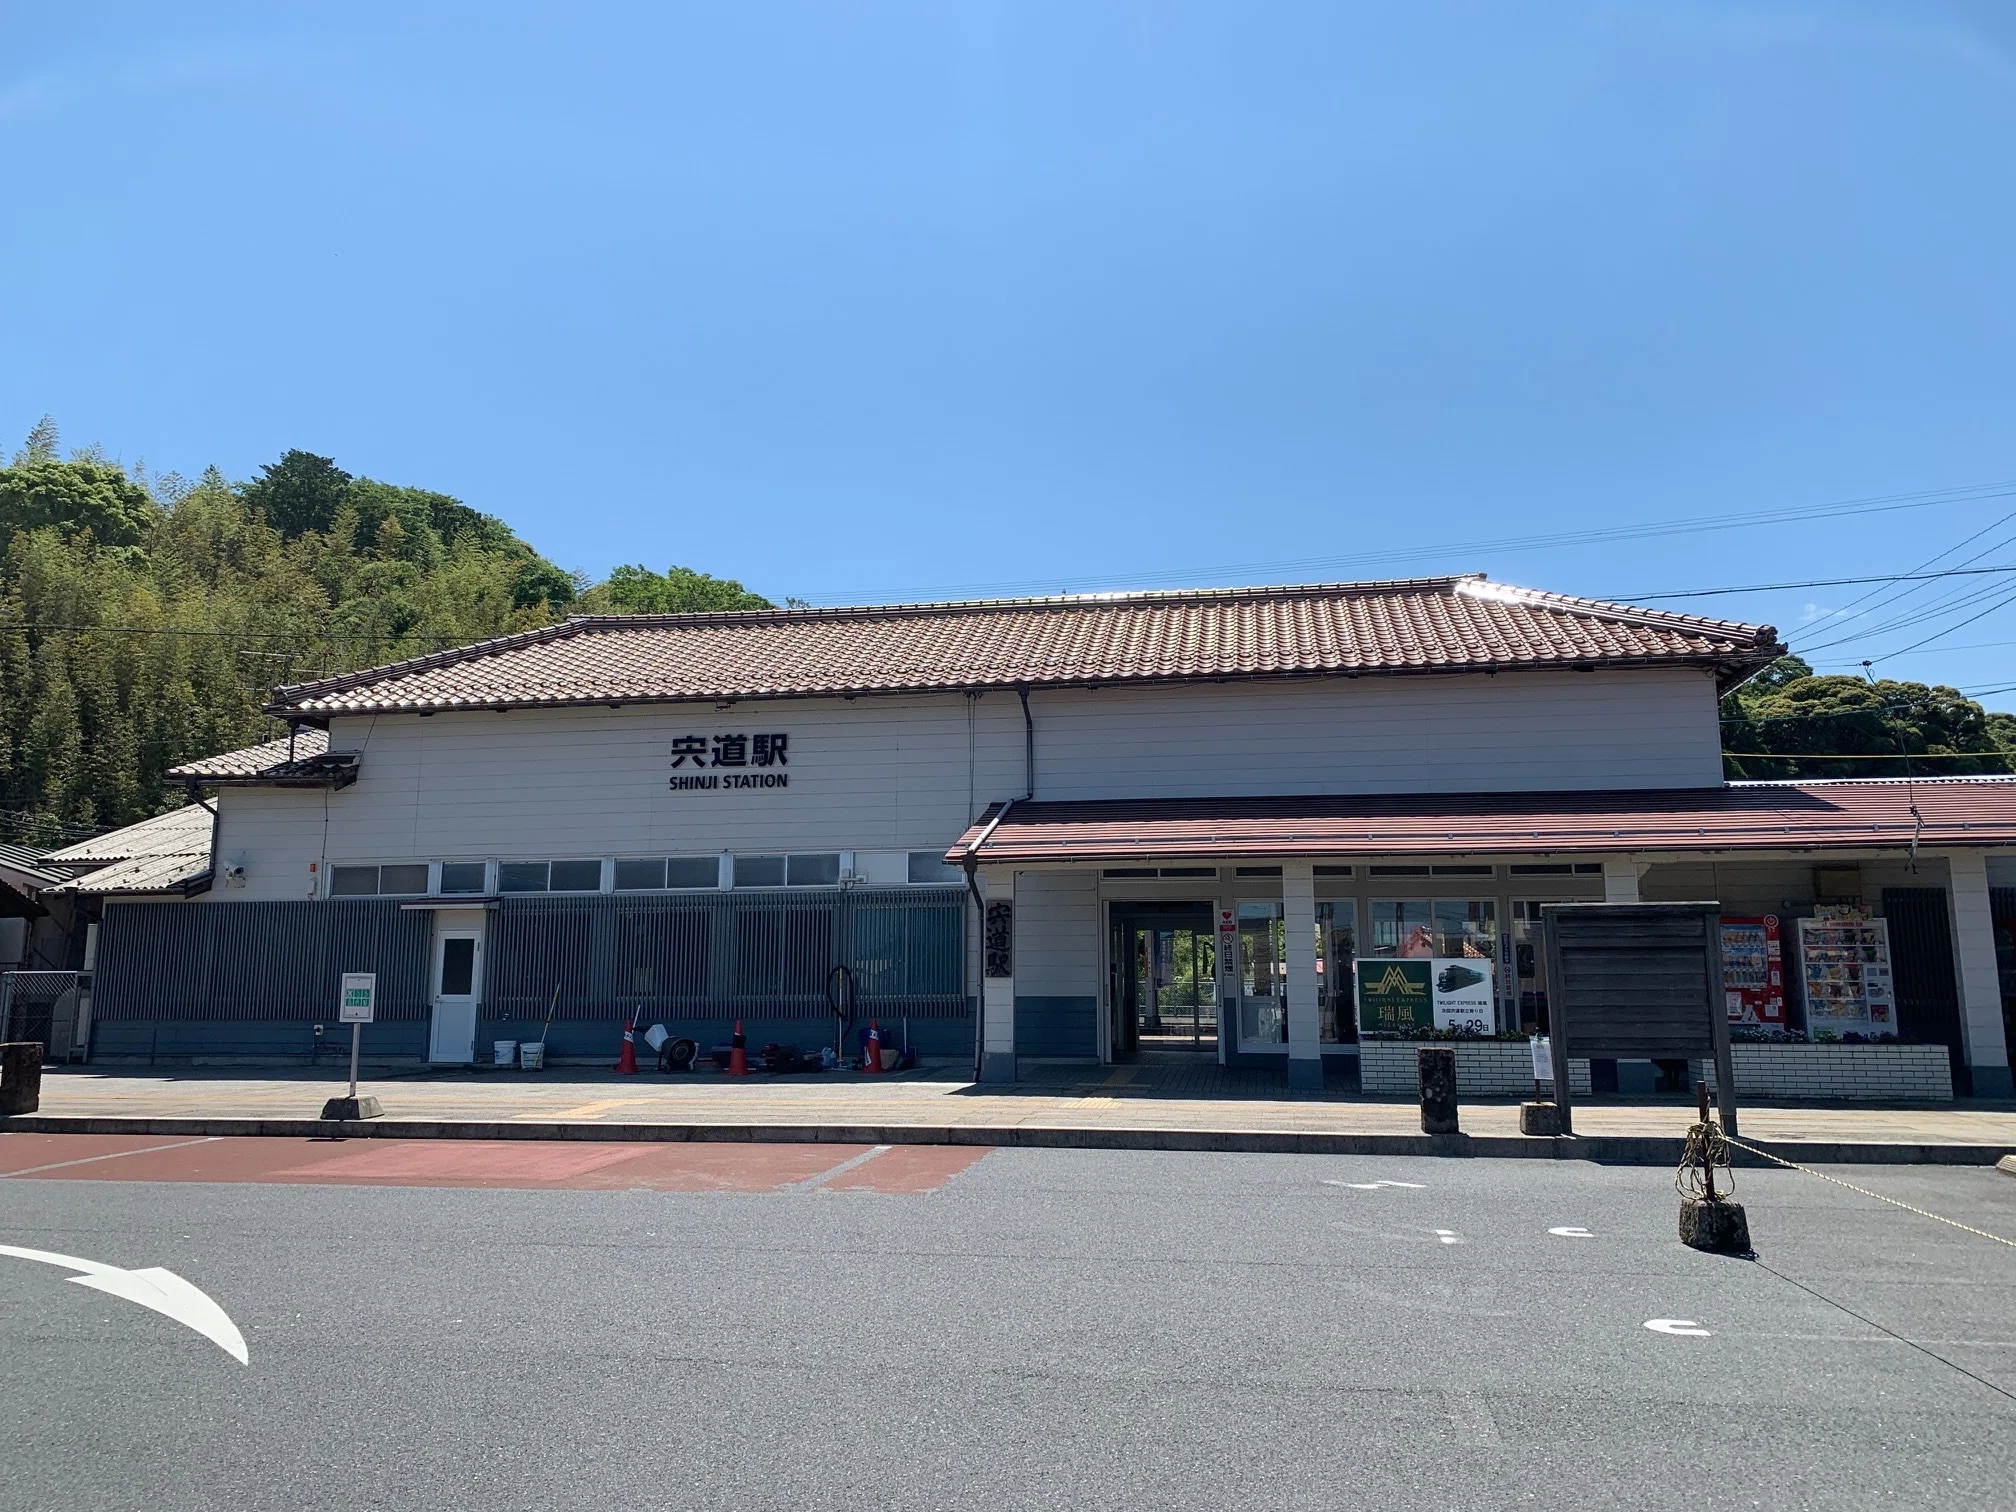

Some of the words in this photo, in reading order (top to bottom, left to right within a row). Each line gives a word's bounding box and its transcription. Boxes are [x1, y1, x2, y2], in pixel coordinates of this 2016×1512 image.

[670, 733, 788, 769] 宍道駅
[669, 776, 718, 790] SHINJI
[723, 773, 788, 789] STATION
[985, 901, 1012, 976] 宍道駅
[1378, 1005, 1415, 1021] 瑞風
